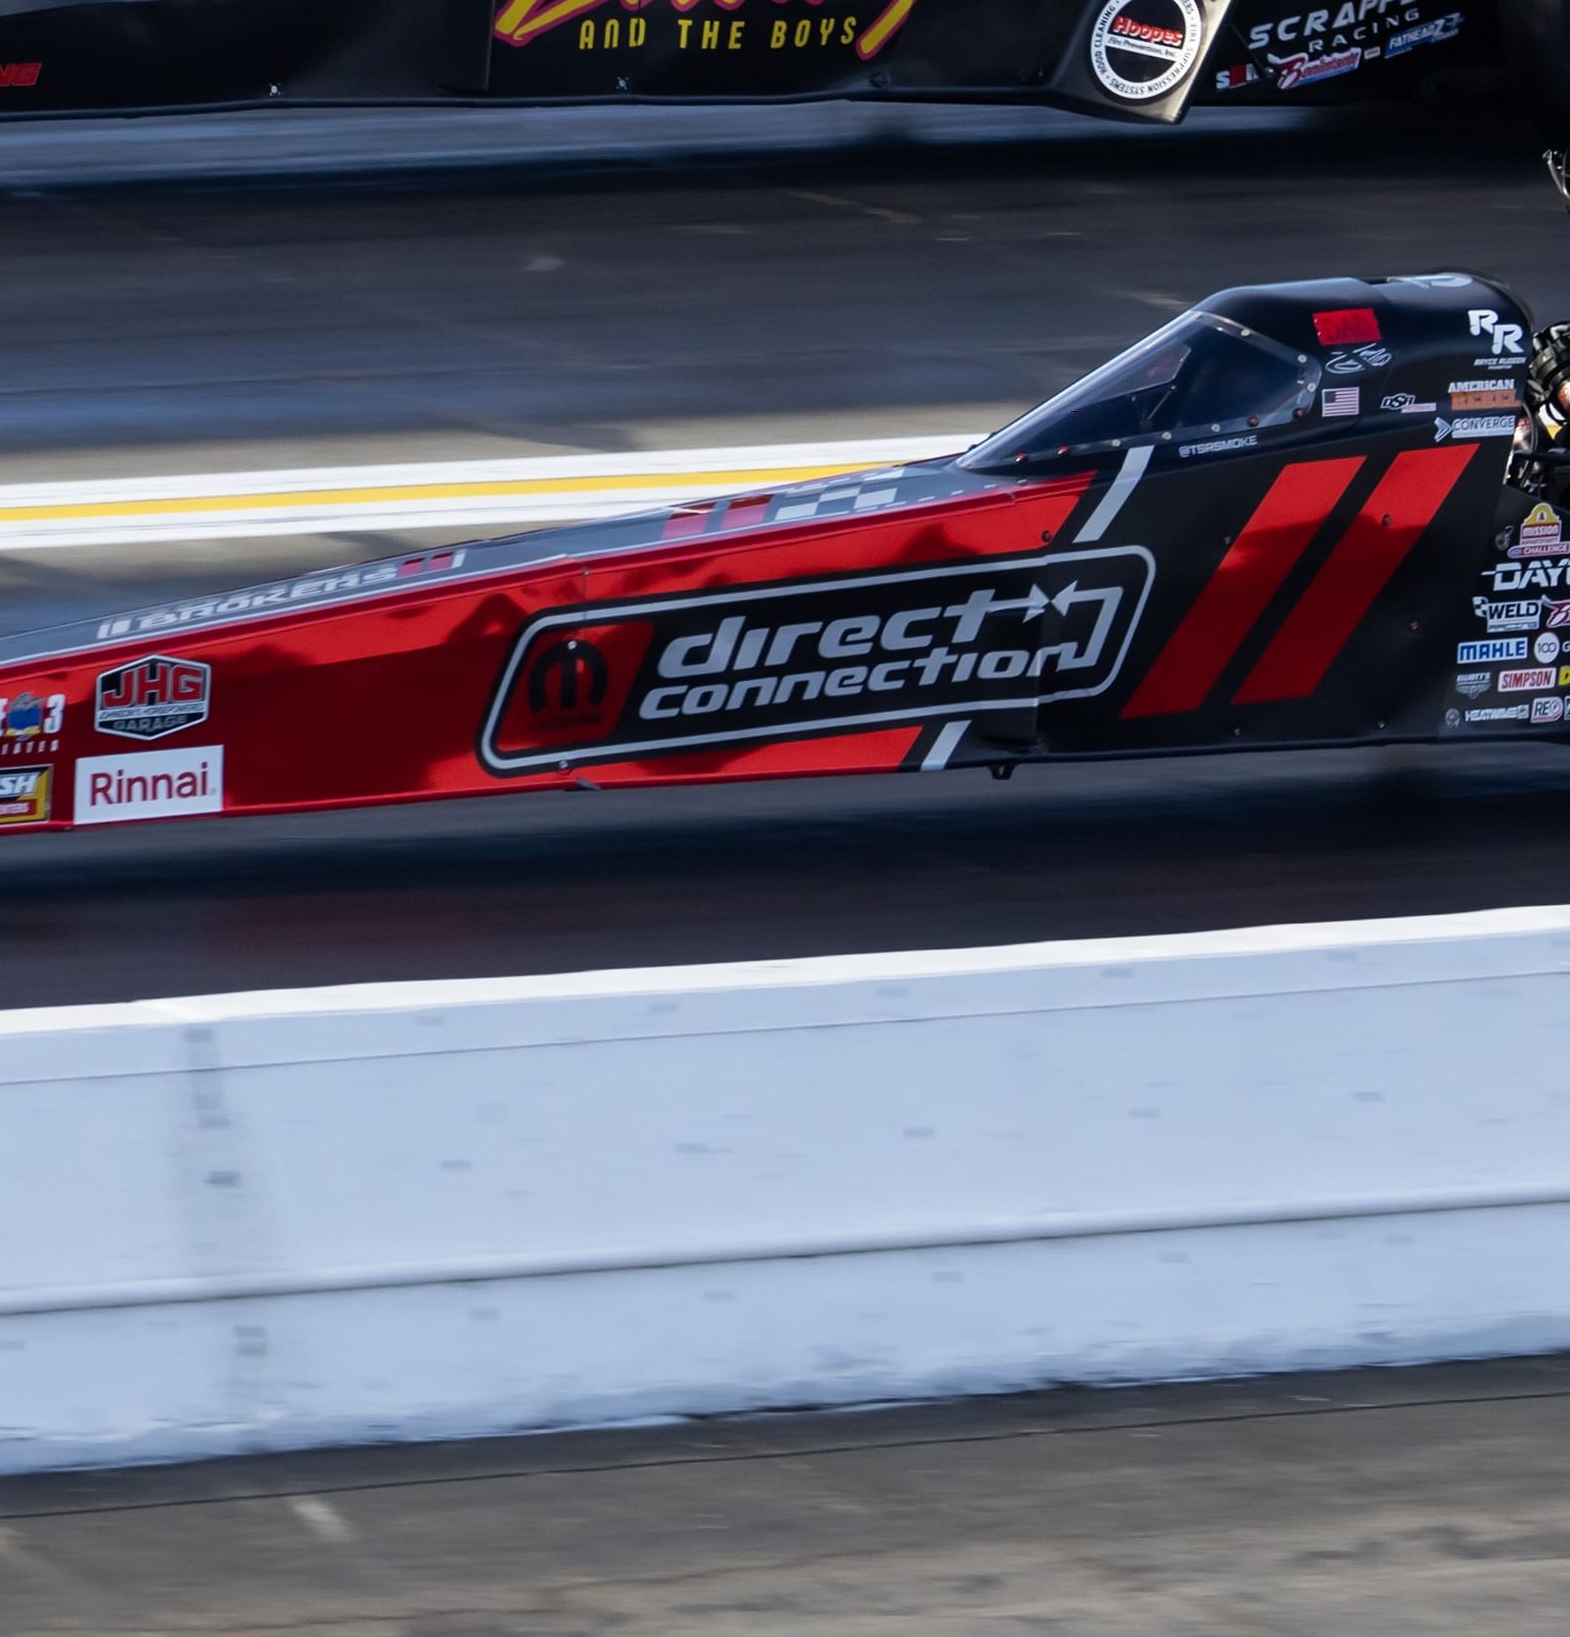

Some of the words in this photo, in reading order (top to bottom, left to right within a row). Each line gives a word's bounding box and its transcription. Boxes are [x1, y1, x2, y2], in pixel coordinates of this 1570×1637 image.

[579, 18, 646, 50] AND
[678, 19, 745, 50] THE
[771, 16, 858, 49] BOYS
[1094, 6, 1116, 48] CLEANING
[1112, 16, 1183, 47] Hoopes
[1308, 7, 1420, 53] RACING
[1094, 51, 1108, 74] HOOD
[1448, 379, 1515, 393] AMERICAN
[1452, 416, 1515, 431] CONVERGE
[1487, 602, 1539, 620] WELD
[657, 588, 1024, 679] direct
[1460, 640, 1526, 661] MAHLE
[102, 663, 205, 709] JHG
[639, 637, 1084, 720] connection
[1502, 670, 1552, 689] SIMPSON
[43, 694, 66, 733] 3
[112, 715, 189, 732] GARAGE
[90, 761, 209, 808] Rinnai
